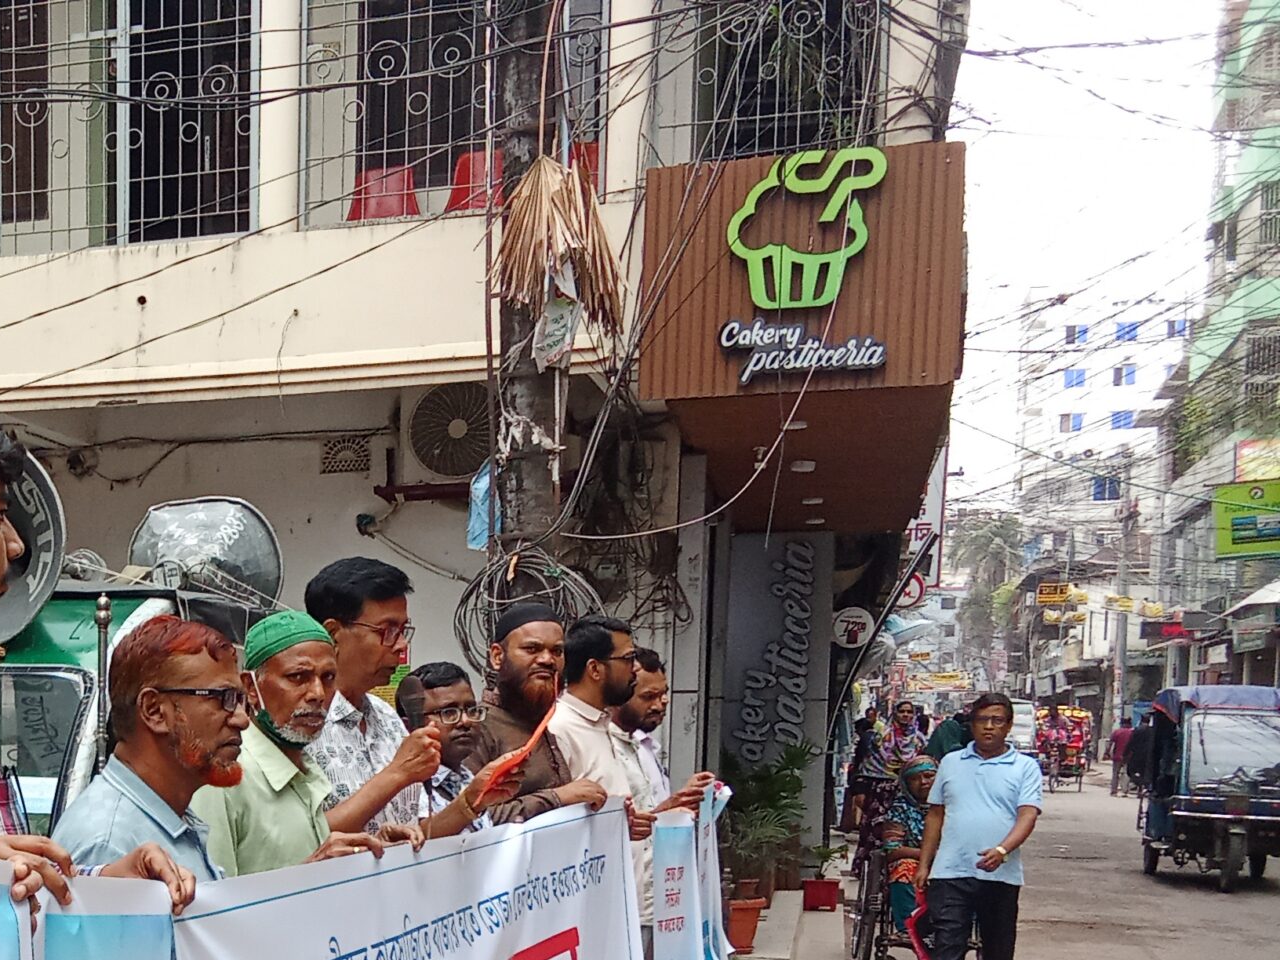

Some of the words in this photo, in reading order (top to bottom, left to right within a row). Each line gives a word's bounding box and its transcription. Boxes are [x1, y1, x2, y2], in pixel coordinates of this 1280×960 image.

[721, 318, 801, 349] Cakery
[741, 338, 884, 383] pasticceria
[732, 669, 777, 762] akery
